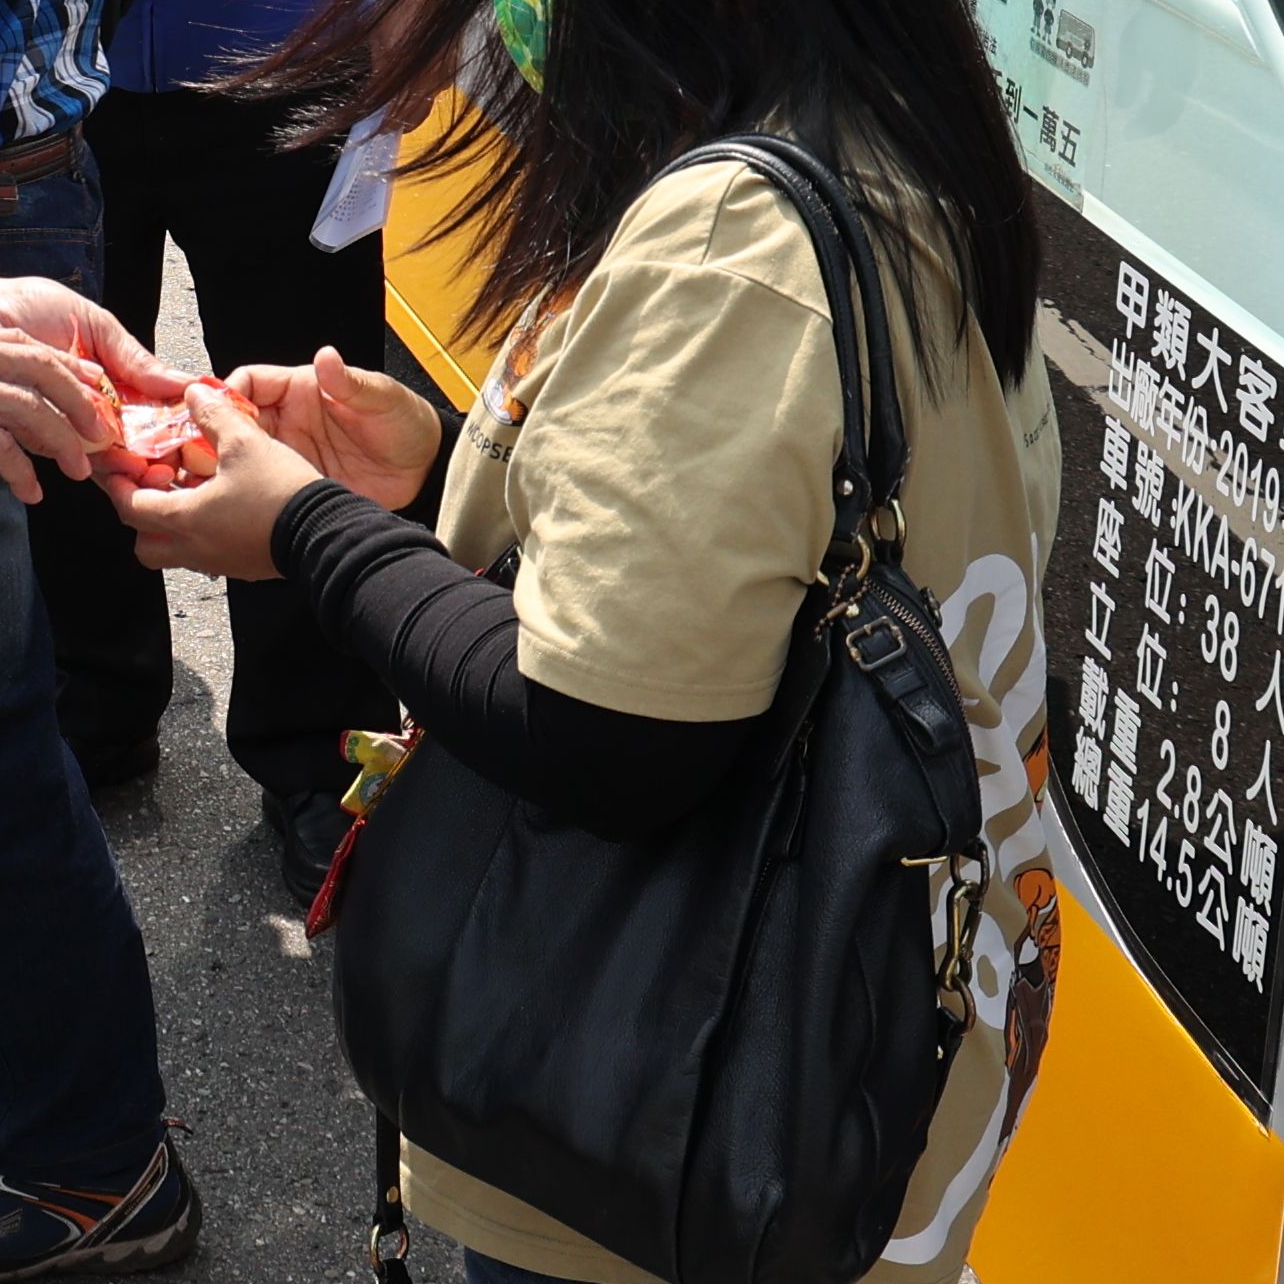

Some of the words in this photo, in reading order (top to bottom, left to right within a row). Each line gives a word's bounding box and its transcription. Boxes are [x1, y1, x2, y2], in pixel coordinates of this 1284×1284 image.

[1116, 261, 1284, 450] 甲類大客
[1201, 594, 1240, 683] 38
[1211, 699, 1232, 771] 8
[1245, 739, 1278, 827] 人
